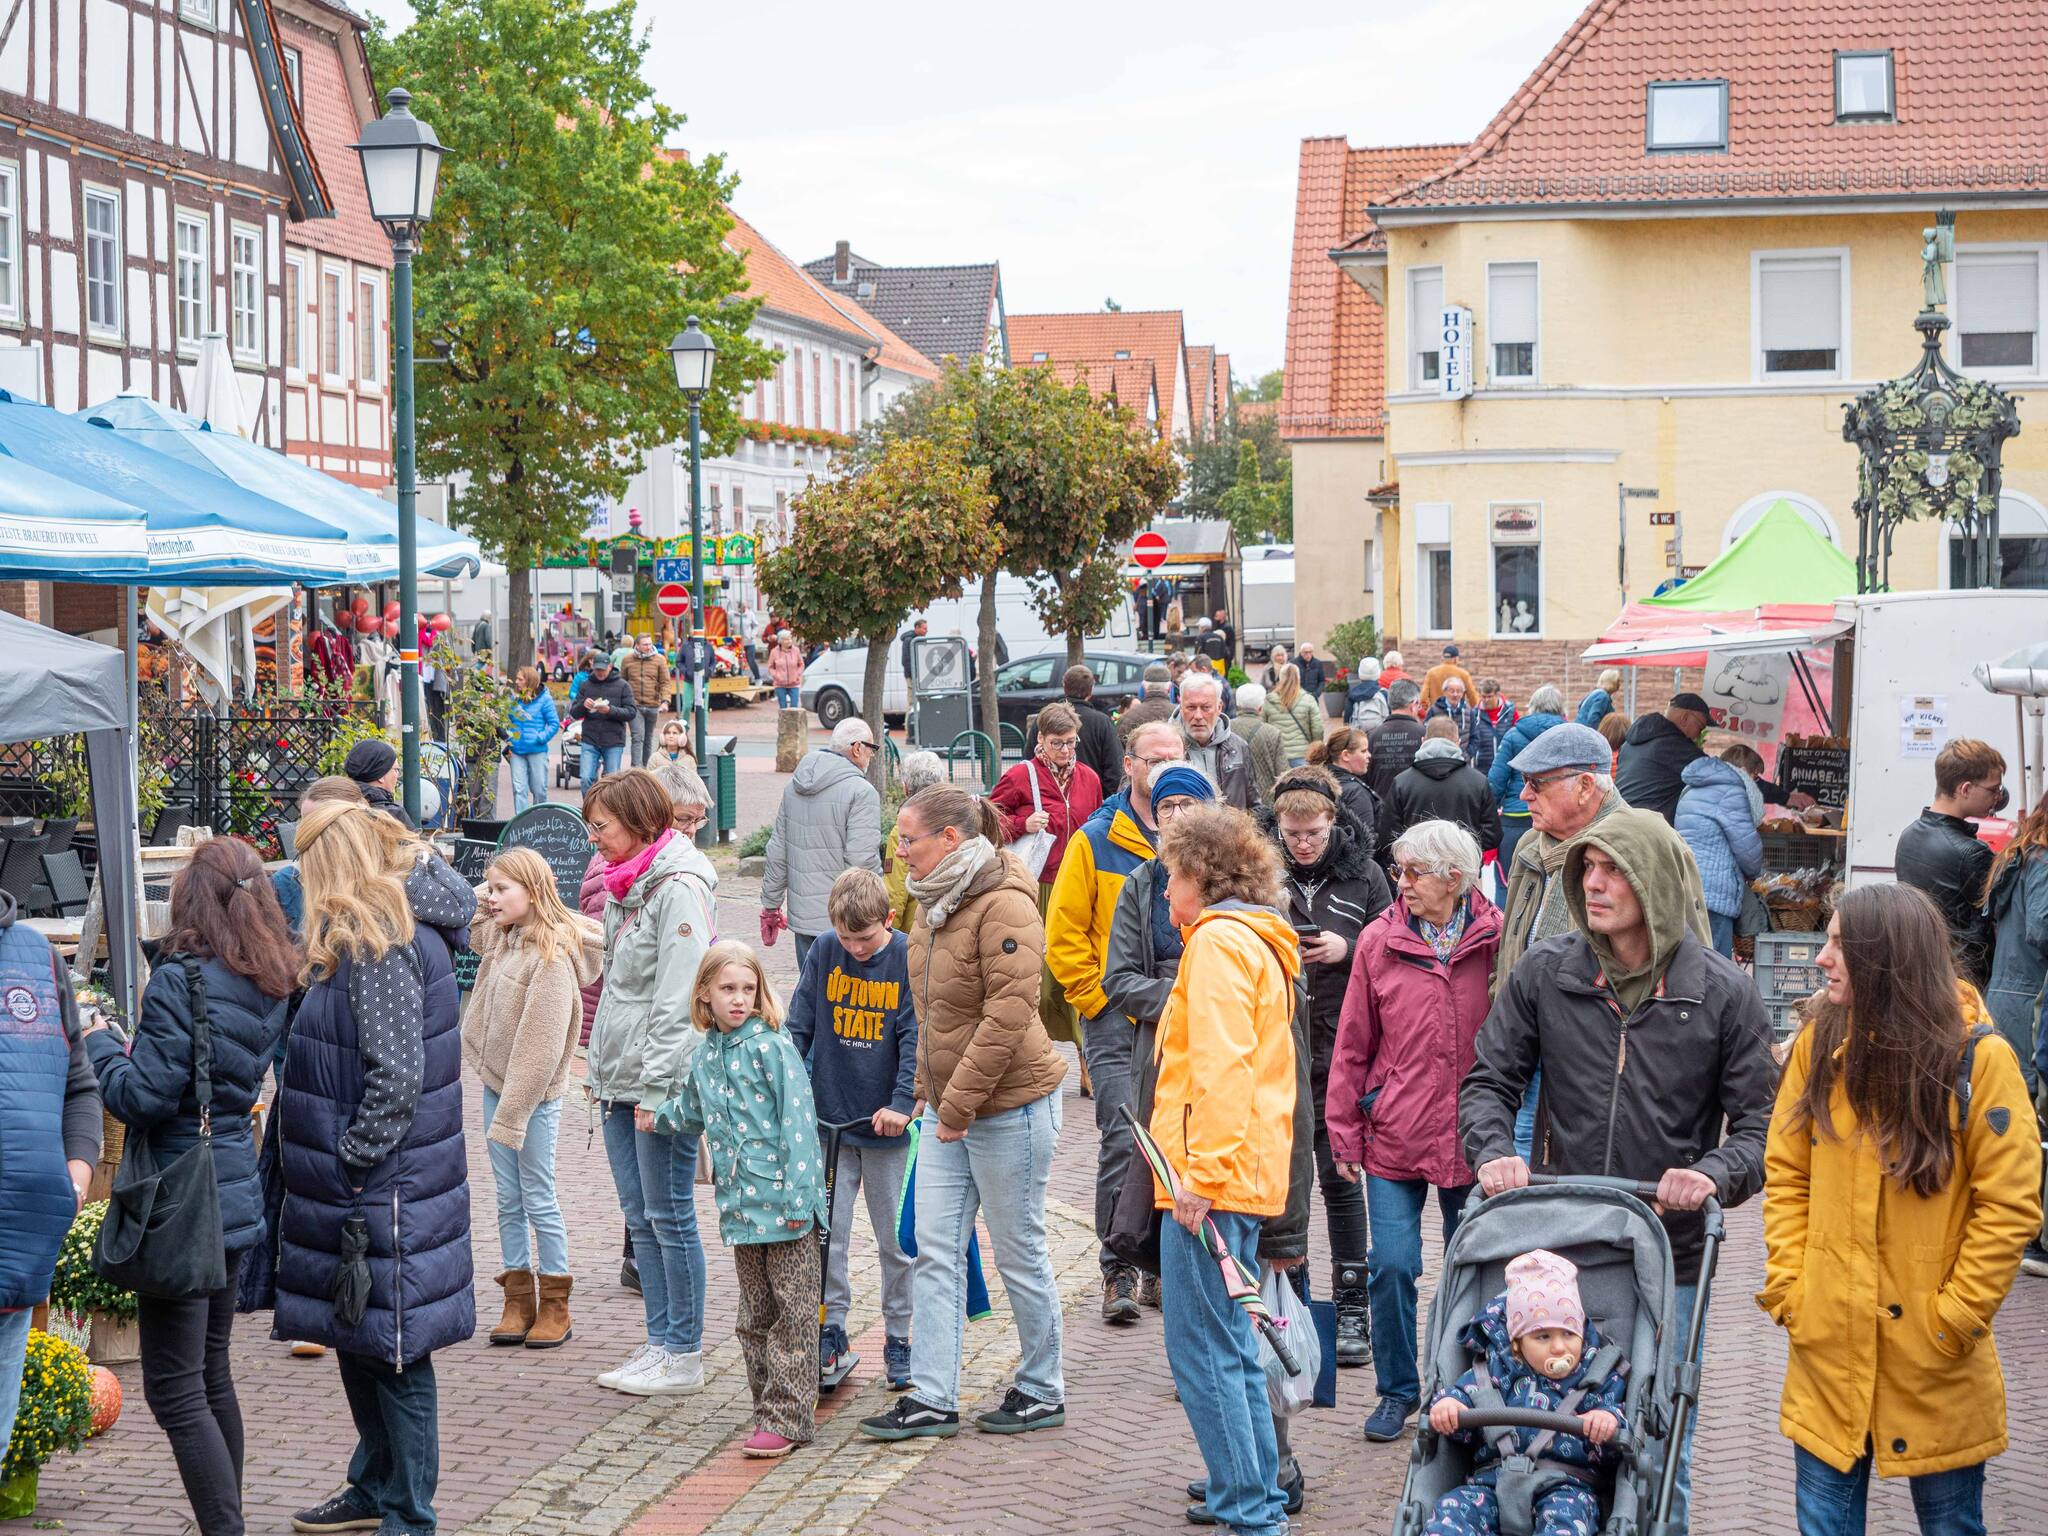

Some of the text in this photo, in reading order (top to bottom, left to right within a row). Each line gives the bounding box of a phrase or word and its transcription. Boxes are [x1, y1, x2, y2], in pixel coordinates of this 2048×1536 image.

[1443, 312, 1461, 392] HOTEL
[1660, 514, 1671, 523] WC
[23, 528, 58, 544] BRAUEREI
[59, 532, 76, 545] DER
[76, 533, 99, 545] WELT
[1709, 706, 1774, 738] Eier
[1791, 767, 1849, 784] ANNABELLE
[827, 965, 900, 1010] UPTOWN
[833, 1005, 885, 1041] STATE
[852, 1040, 872, 1049] HRLM
